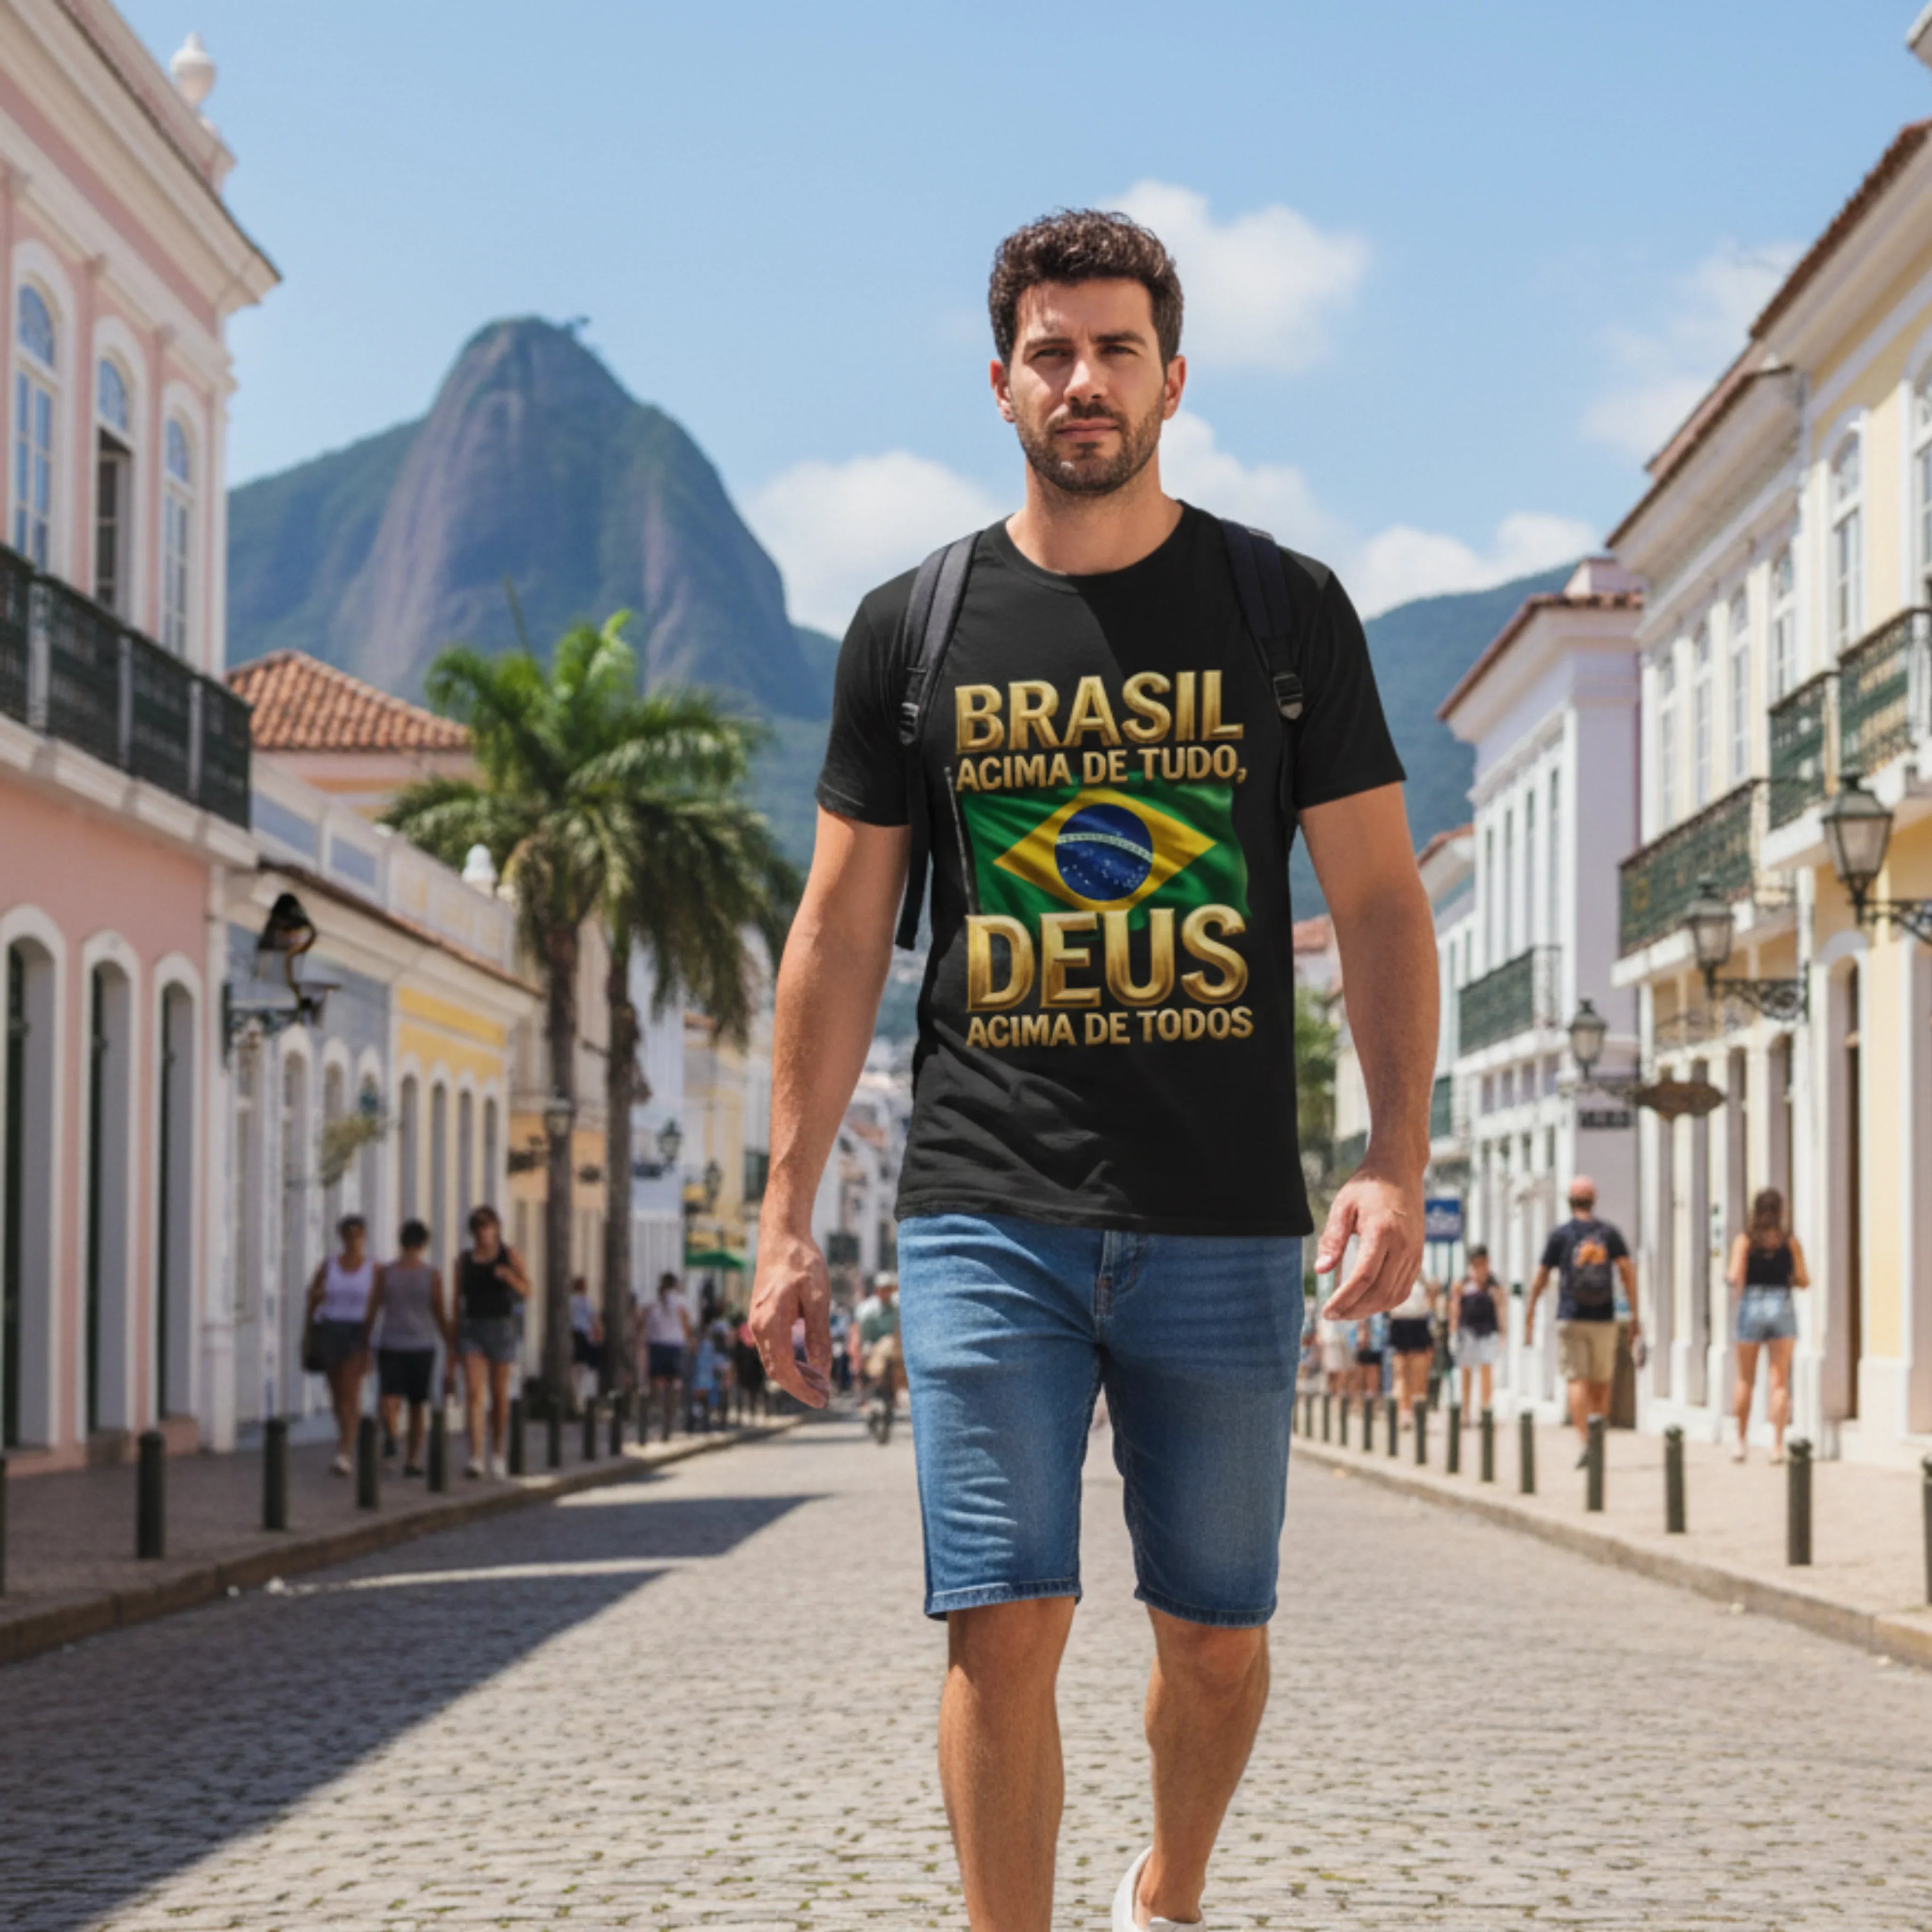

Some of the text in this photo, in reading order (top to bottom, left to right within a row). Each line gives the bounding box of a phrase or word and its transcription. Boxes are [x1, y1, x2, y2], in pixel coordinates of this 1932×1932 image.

[955, 670, 1243, 754] BRASIL
[957, 745, 1247, 791] ACIMA DE TUDO,
[965, 904, 1249, 1011] DEUS
[966, 1006, 1254, 1048] ACIMA DE TODOS
